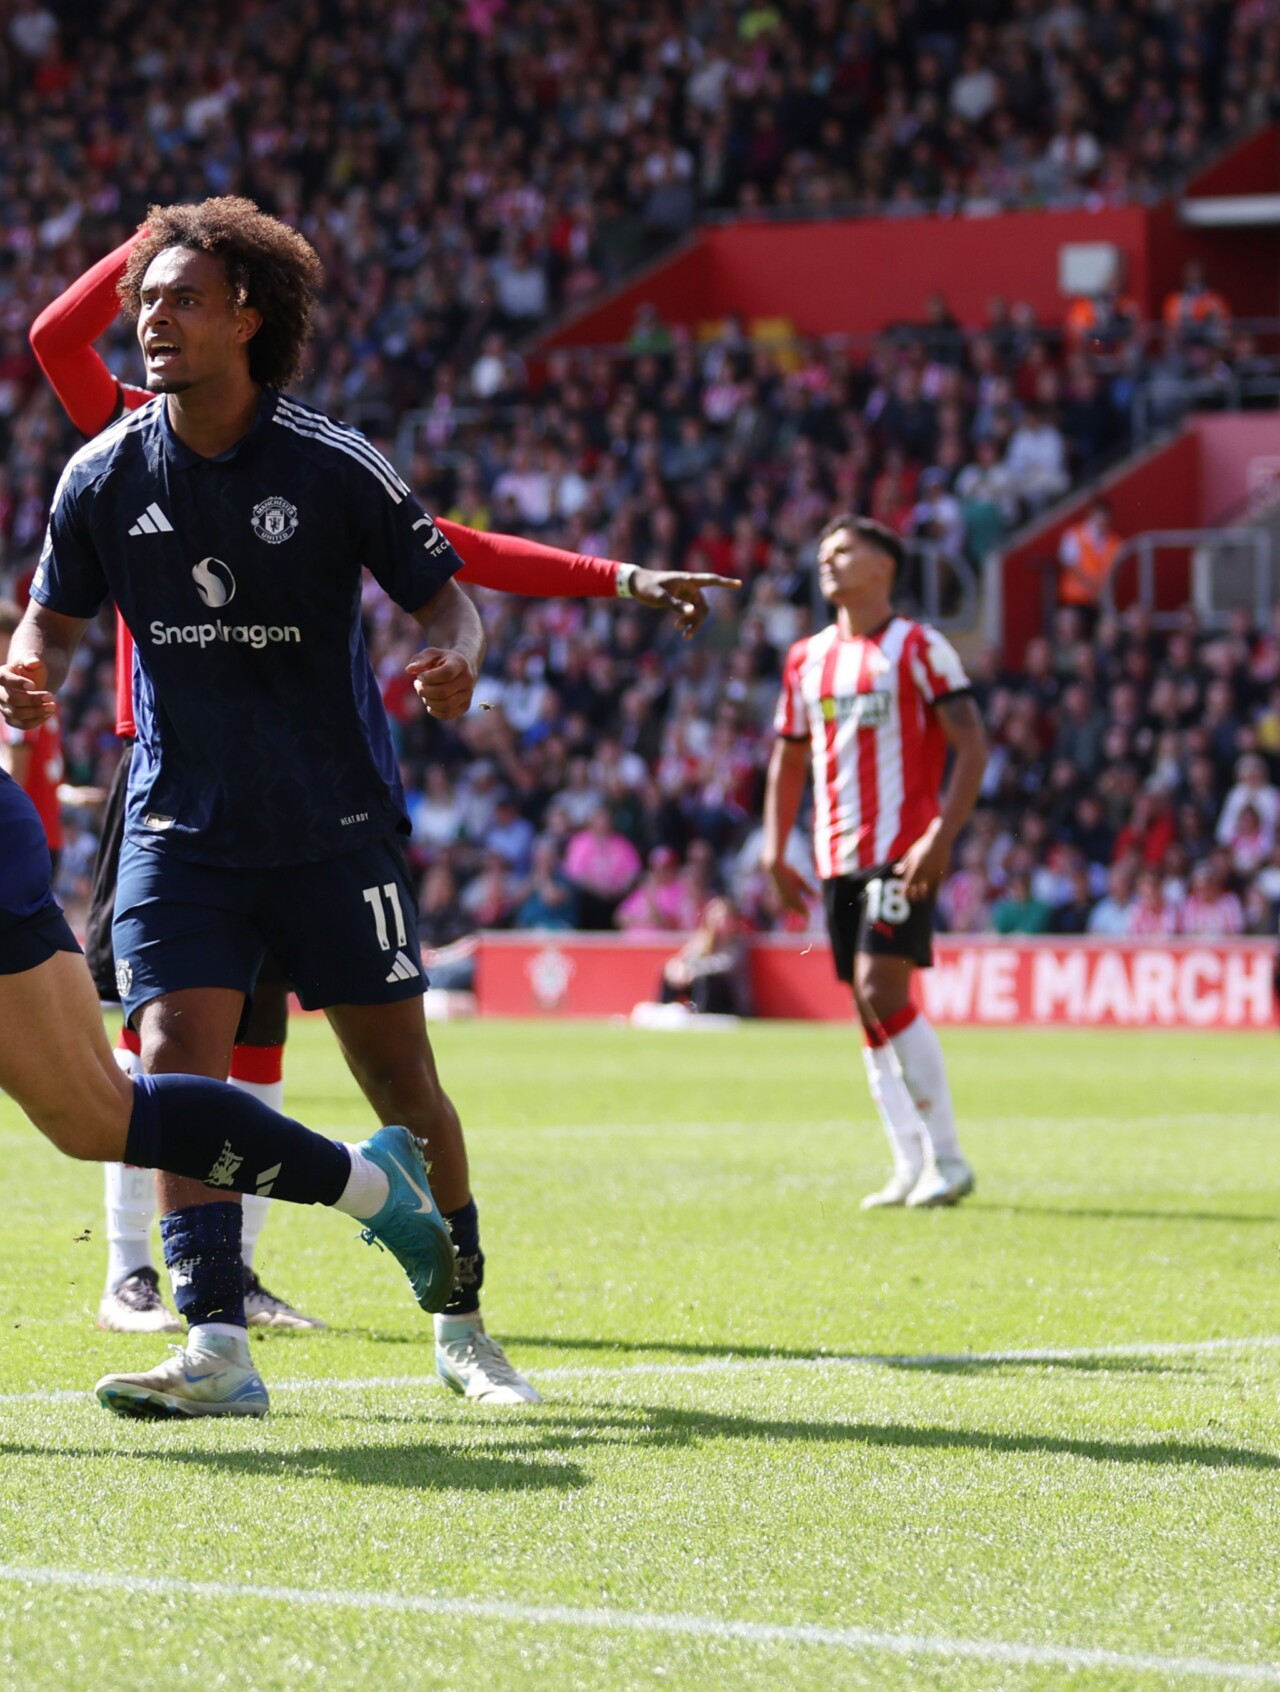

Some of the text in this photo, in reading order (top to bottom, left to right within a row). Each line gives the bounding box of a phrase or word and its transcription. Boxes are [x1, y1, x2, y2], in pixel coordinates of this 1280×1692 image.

[150, 619, 301, 648] Snapdragon
[362, 882, 407, 951] 11
[866, 877, 910, 924] 18
[923, 949, 1270, 1024] WE MARCH
